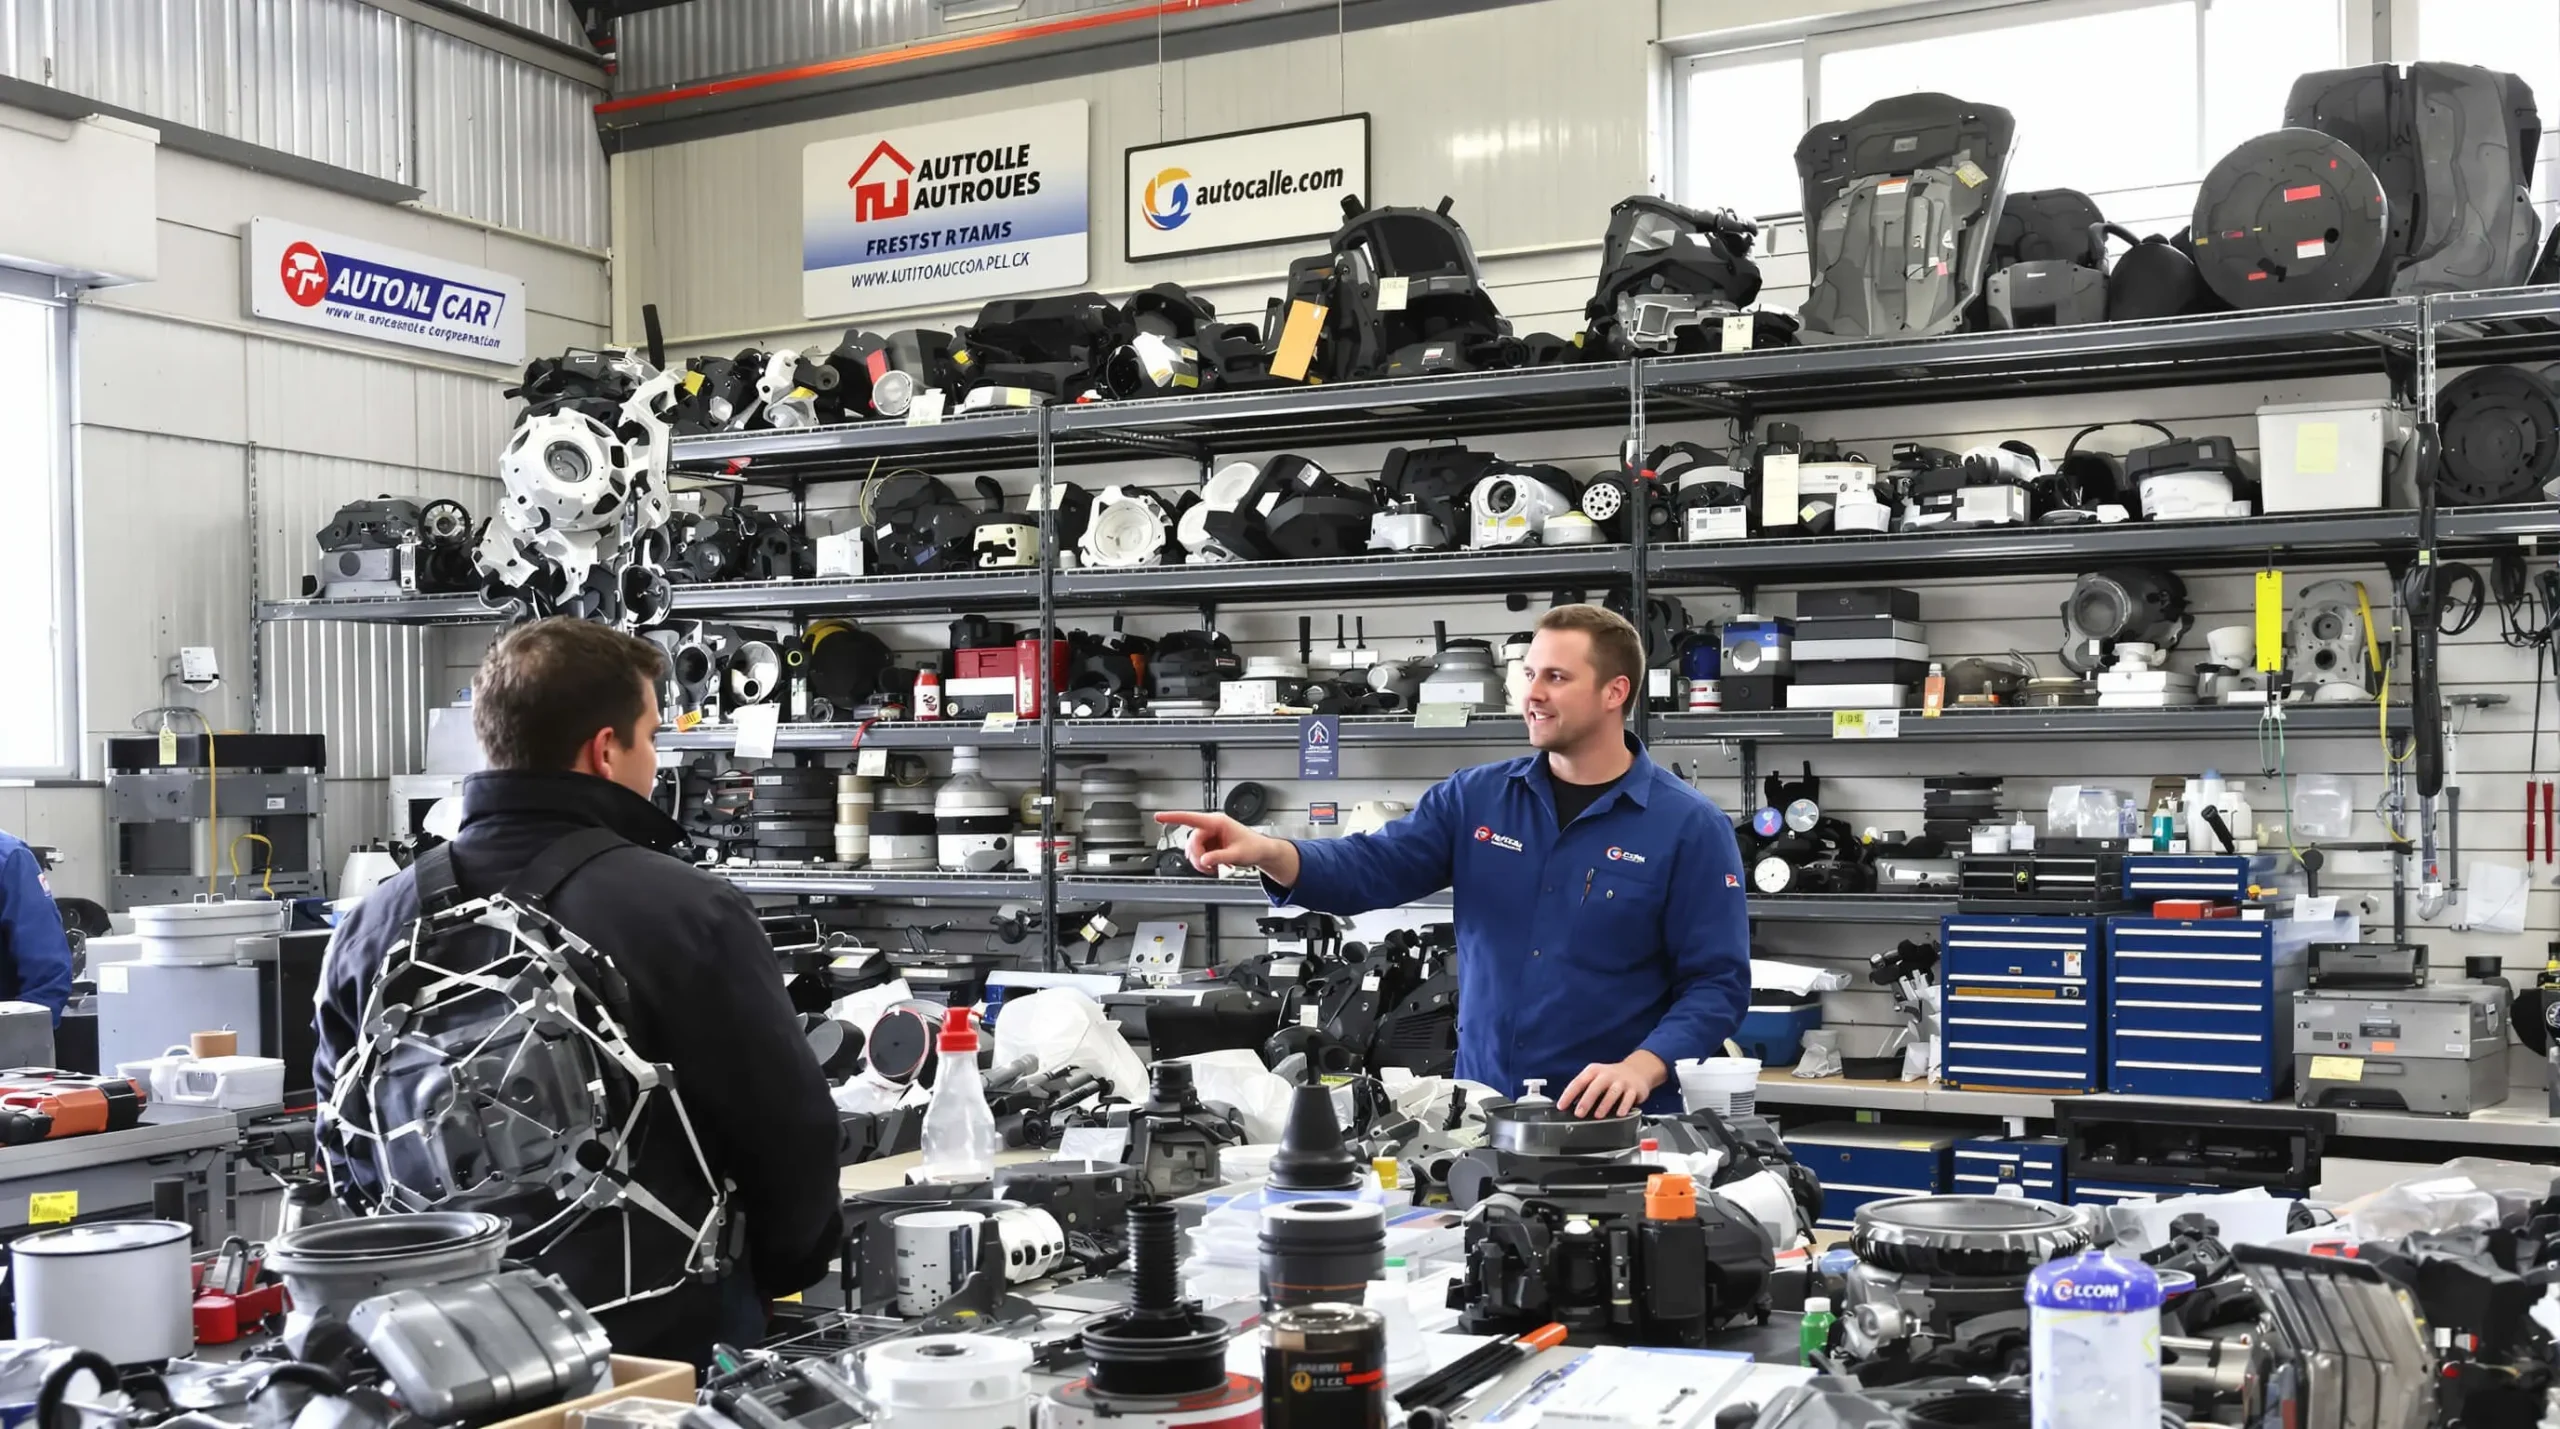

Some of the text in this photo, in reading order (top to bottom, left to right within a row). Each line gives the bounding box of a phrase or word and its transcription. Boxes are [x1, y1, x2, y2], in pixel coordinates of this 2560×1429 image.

[917, 143, 1030, 183] AUTTOLLE
[913, 171, 1041, 210] AUTROUES
[1196, 167, 1344, 206] autocalle.com
[442, 293, 492, 326] CAR
